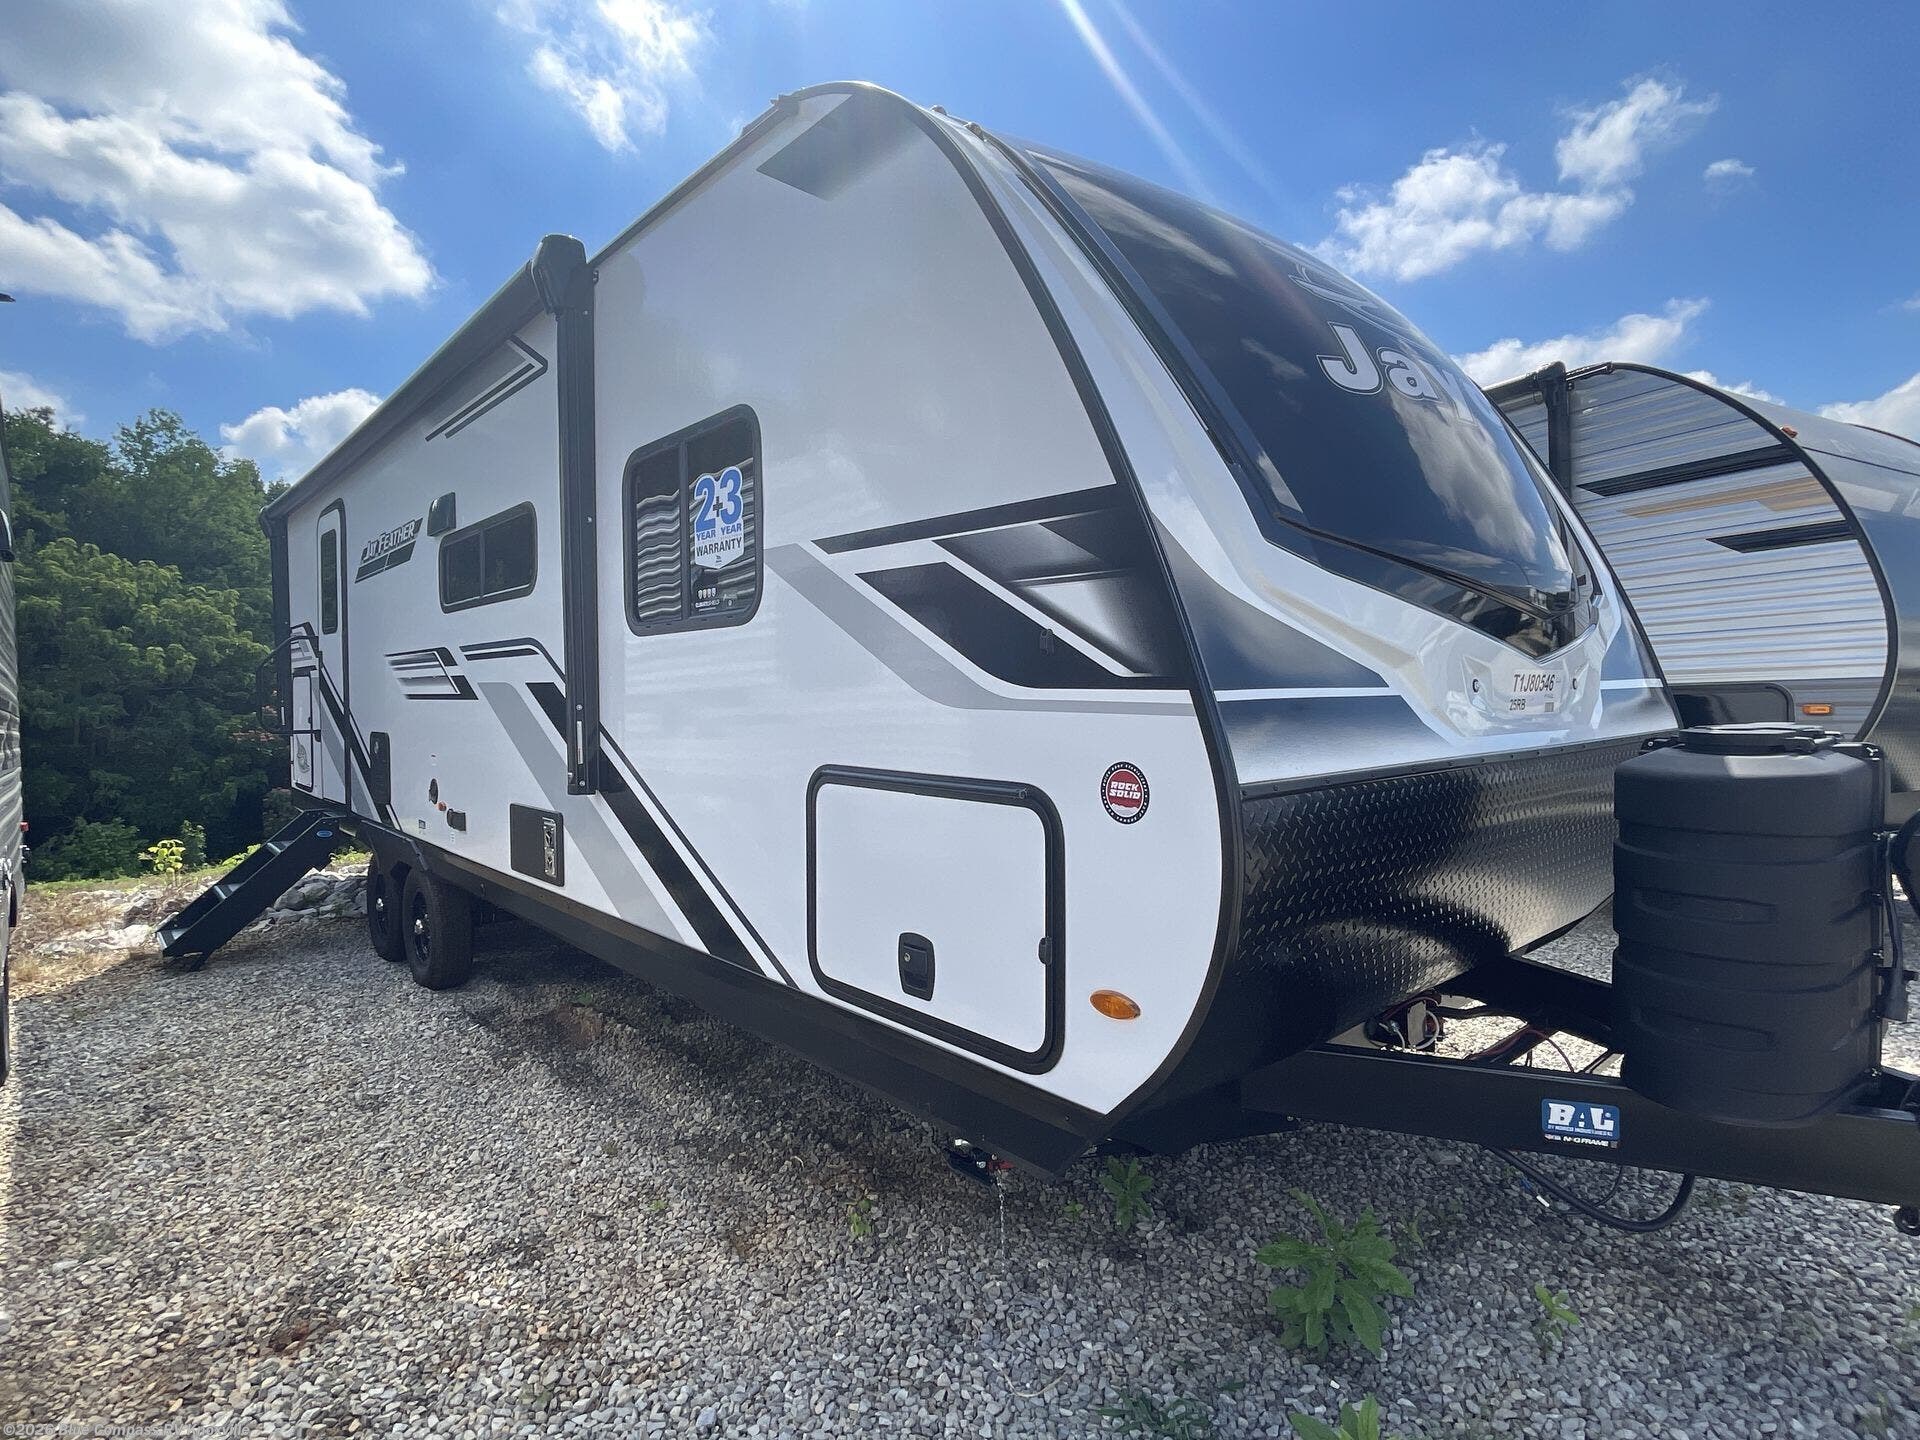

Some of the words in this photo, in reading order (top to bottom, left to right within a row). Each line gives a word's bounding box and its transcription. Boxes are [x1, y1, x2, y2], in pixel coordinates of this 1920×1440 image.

[696, 529, 716, 541] YEAR
[720, 522, 742, 535] YEAR
[696, 537, 742, 557] WARRANTY
[1513, 674, 1556, 692] T1J80546
[1509, 698, 1526, 711] 25RB
[1109, 788, 1141, 800] SOLID
[1110, 781, 1139, 792] ROCK
[1548, 1102, 1615, 1131] BAL
[1581, 1137, 1609, 1147] FRAME
